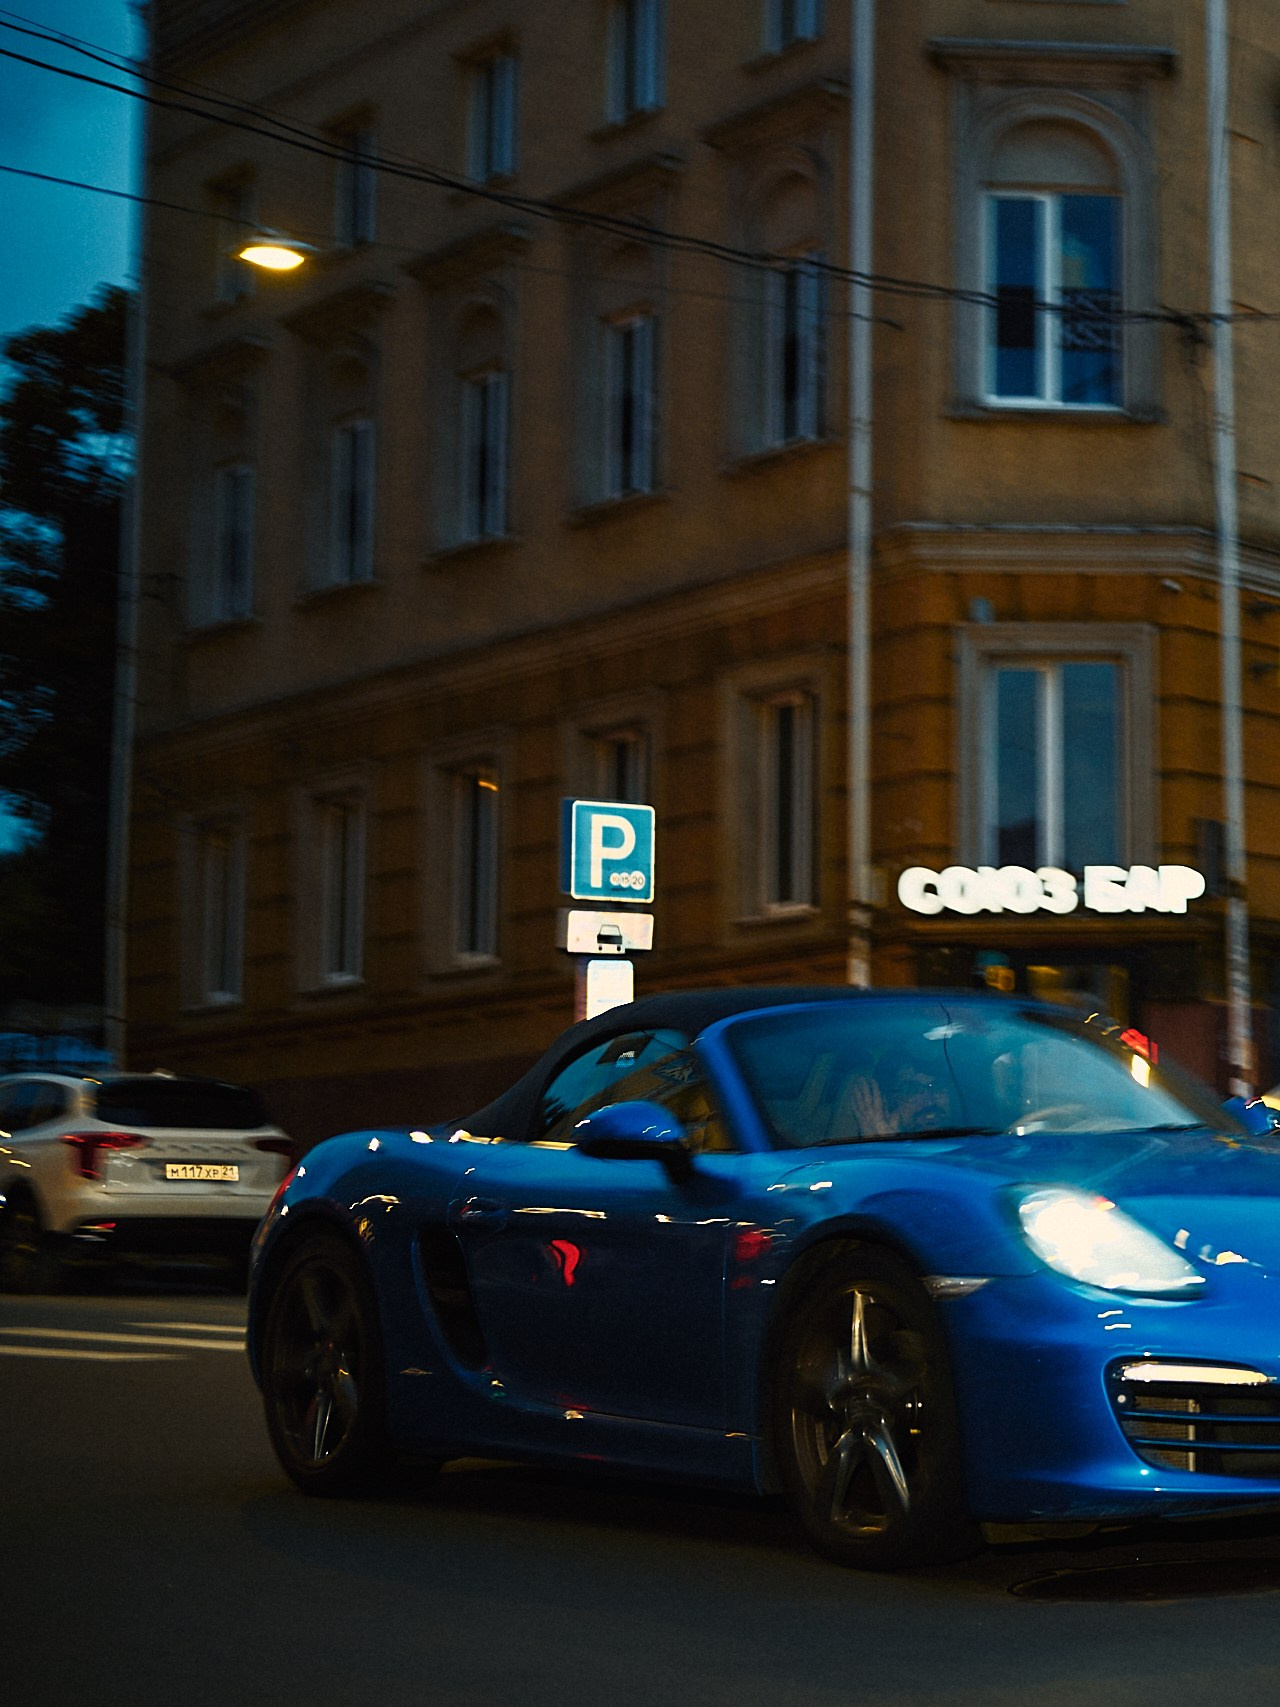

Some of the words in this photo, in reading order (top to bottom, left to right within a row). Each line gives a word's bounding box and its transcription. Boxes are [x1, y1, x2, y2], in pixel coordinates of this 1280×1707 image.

[591, 814, 636, 888] P
[632, 876, 644, 886] 20
[898, 866, 1078, 914] СОЮЗ
[1084, 865, 1205, 914] БАР
[222, 1166, 234, 1176] 21
